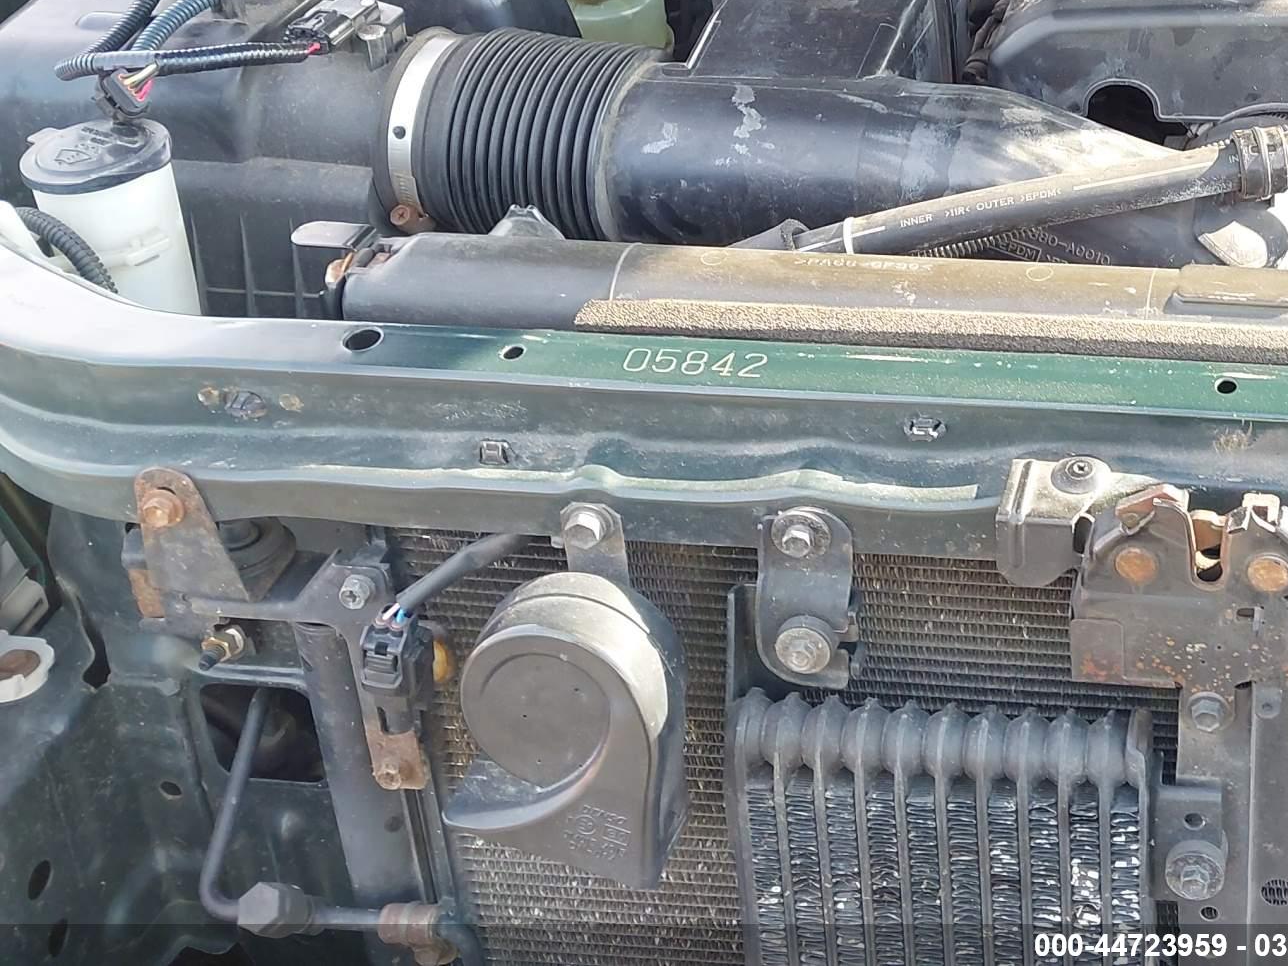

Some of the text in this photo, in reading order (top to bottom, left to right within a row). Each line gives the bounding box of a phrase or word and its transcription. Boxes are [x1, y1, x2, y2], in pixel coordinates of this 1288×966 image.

[900, 213, 933, 228] INNER
[975, 196, 1015, 212] OUTER
[622, 347, 768, 378] 05842
